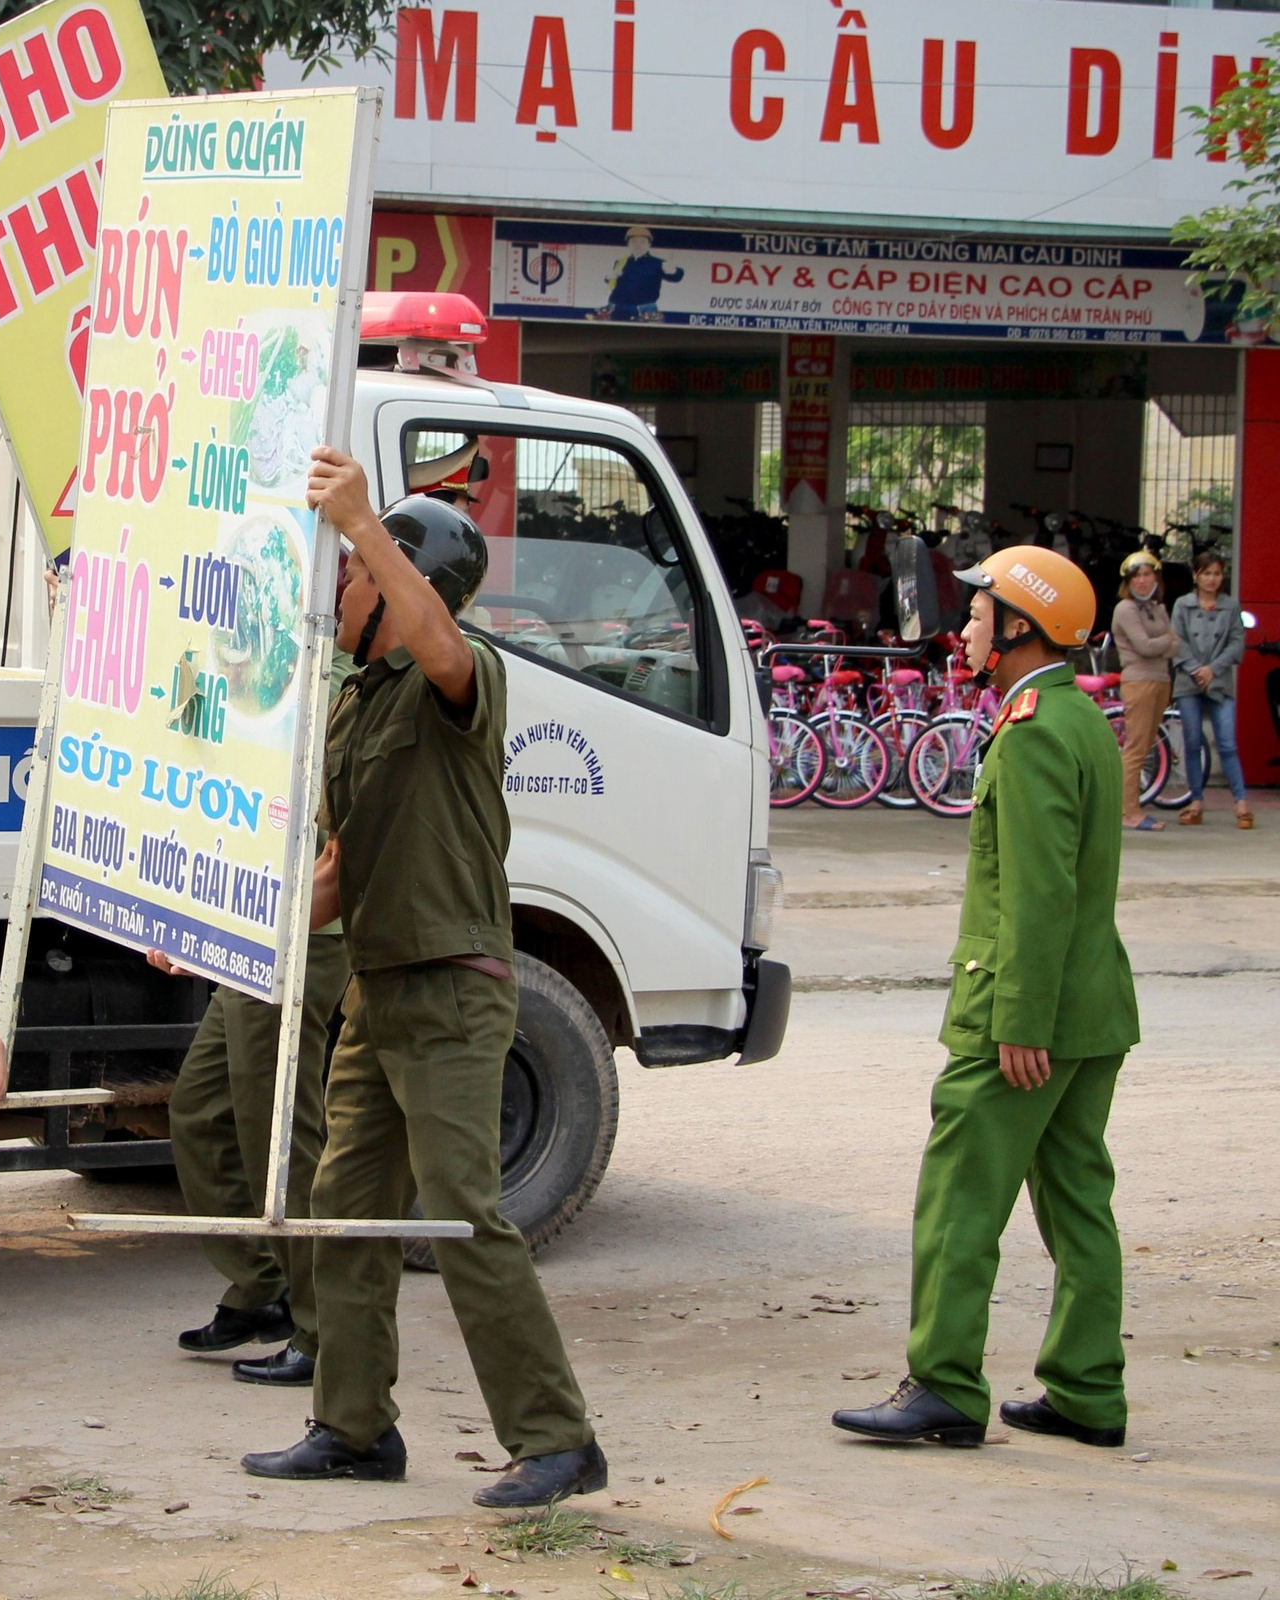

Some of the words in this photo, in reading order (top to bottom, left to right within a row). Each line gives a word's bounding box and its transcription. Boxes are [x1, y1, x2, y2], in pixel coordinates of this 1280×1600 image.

[144, 113, 217, 173] DŨNG
[225, 108, 305, 176] QUÁN
[93, 195, 189, 340] BÚN
[207, 200, 240, 284] BÒ
[244, 201, 283, 287] GIÒ
[288, 216, 343, 303] MỌC
[710, 257, 783, 288] DÂY
[792, 264, 816, 289] &
[827, 262, 899, 292] CÁP
[908, 270, 987, 301] ĐIỆN
[999, 274, 1073, 300] CAO
[741, 233, 818, 256] TRUNG
[877, 238, 971, 263] THƯƠNG
[709, 296, 743, 312] ĐƯỢC
[832, 296, 873, 317] CÔNG
[876, 300, 896, 317] TY
[896, 301, 916, 318] CP
[918, 300, 946, 320] DÂY
[949, 301, 981, 325] ĐIỆN
[984, 302, 1004, 321] VÀ
[1006, 303, 1048, 323] PHÍCH
[1124, 308, 1153, 326] PHÚ
[895, 324, 909, 335] AN
[82, 347, 176, 503] PHỞ
[188, 427, 249, 515] LÒNG
[64, 528, 150, 714] CHÁO
[179, 551, 241, 630] LƯƠN
[1022, 572, 1058, 603] SHB
[58, 732, 132, 788] SÚP
[141, 759, 264, 833] LƯƠN
[506, 771, 525, 797] ĐỘI
[509, 733, 527, 756] AN
[526, 718, 565, 744] HUYỆN
[566, 729, 588, 755] YÊN
[582, 747, 605, 796] THÀNH
[51, 804, 77, 856] BIA
[81, 815, 128, 878] RƯỢU
[138, 829, 188, 895] NƯỚC
[191, 839, 229, 911] GIẢI
[230, 864, 282, 928] KHÁT
[41, 877, 58, 903] ĐC:
[59, 881, 84, 915] KHỐI
[85, 898, 91, 916] 1
[98, 899, 115, 932] THỊ
[116, 903, 145, 938] TRẤN
[152, 919, 167, 945] YT
[180, 931, 200, 960] ĐT:
[200, 939, 274, 989] 0988.686.528
